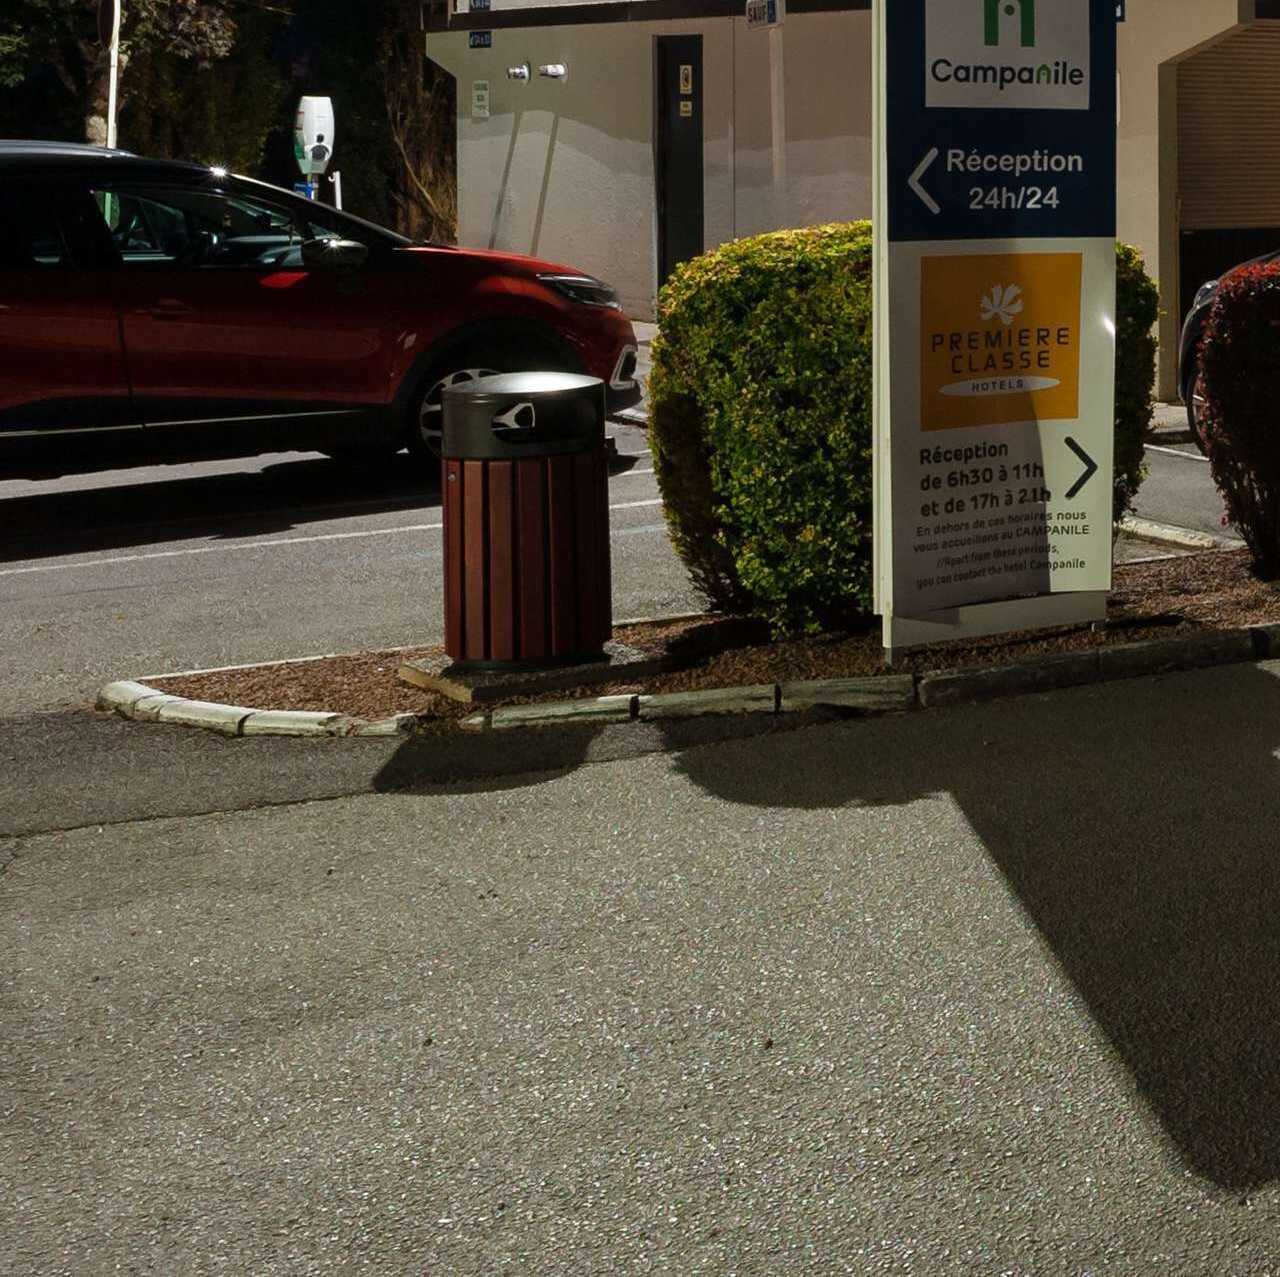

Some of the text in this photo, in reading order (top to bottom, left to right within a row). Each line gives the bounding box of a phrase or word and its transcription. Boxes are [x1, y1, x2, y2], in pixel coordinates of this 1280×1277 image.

[748, 5, 767, 22] SAUF
[931, 58, 1085, 90] Campanile
[946, 148, 1083, 177] Réception
[969, 186, 1060, 210] 24h/24
[931, 327, 1070, 353] PREMIERE
[951, 350, 1051, 374] CLASSE
[972, 379, 1024, 392] HOTELS
[920, 441, 1008, 465] Réception
[920, 464, 1044, 491] de 6h30 à 11h
[920, 487, 1051, 517] et de 17h à 21h
[917, 511, 1087, 537] En dehors de ces horaires nous
[913, 525, 1090, 553] vous accueillons au CAMPANILE
[971, 551, 991, 563] from
[993, 548, 1016, 559] these
[1018, 543, 1060, 557] periods,
[916, 576, 934, 590] you
[936, 573, 952, 585] can
[954, 567, 987, 582] contact
[988, 565, 1002, 575] the
[1030, 558, 1086, 571] Campanile
